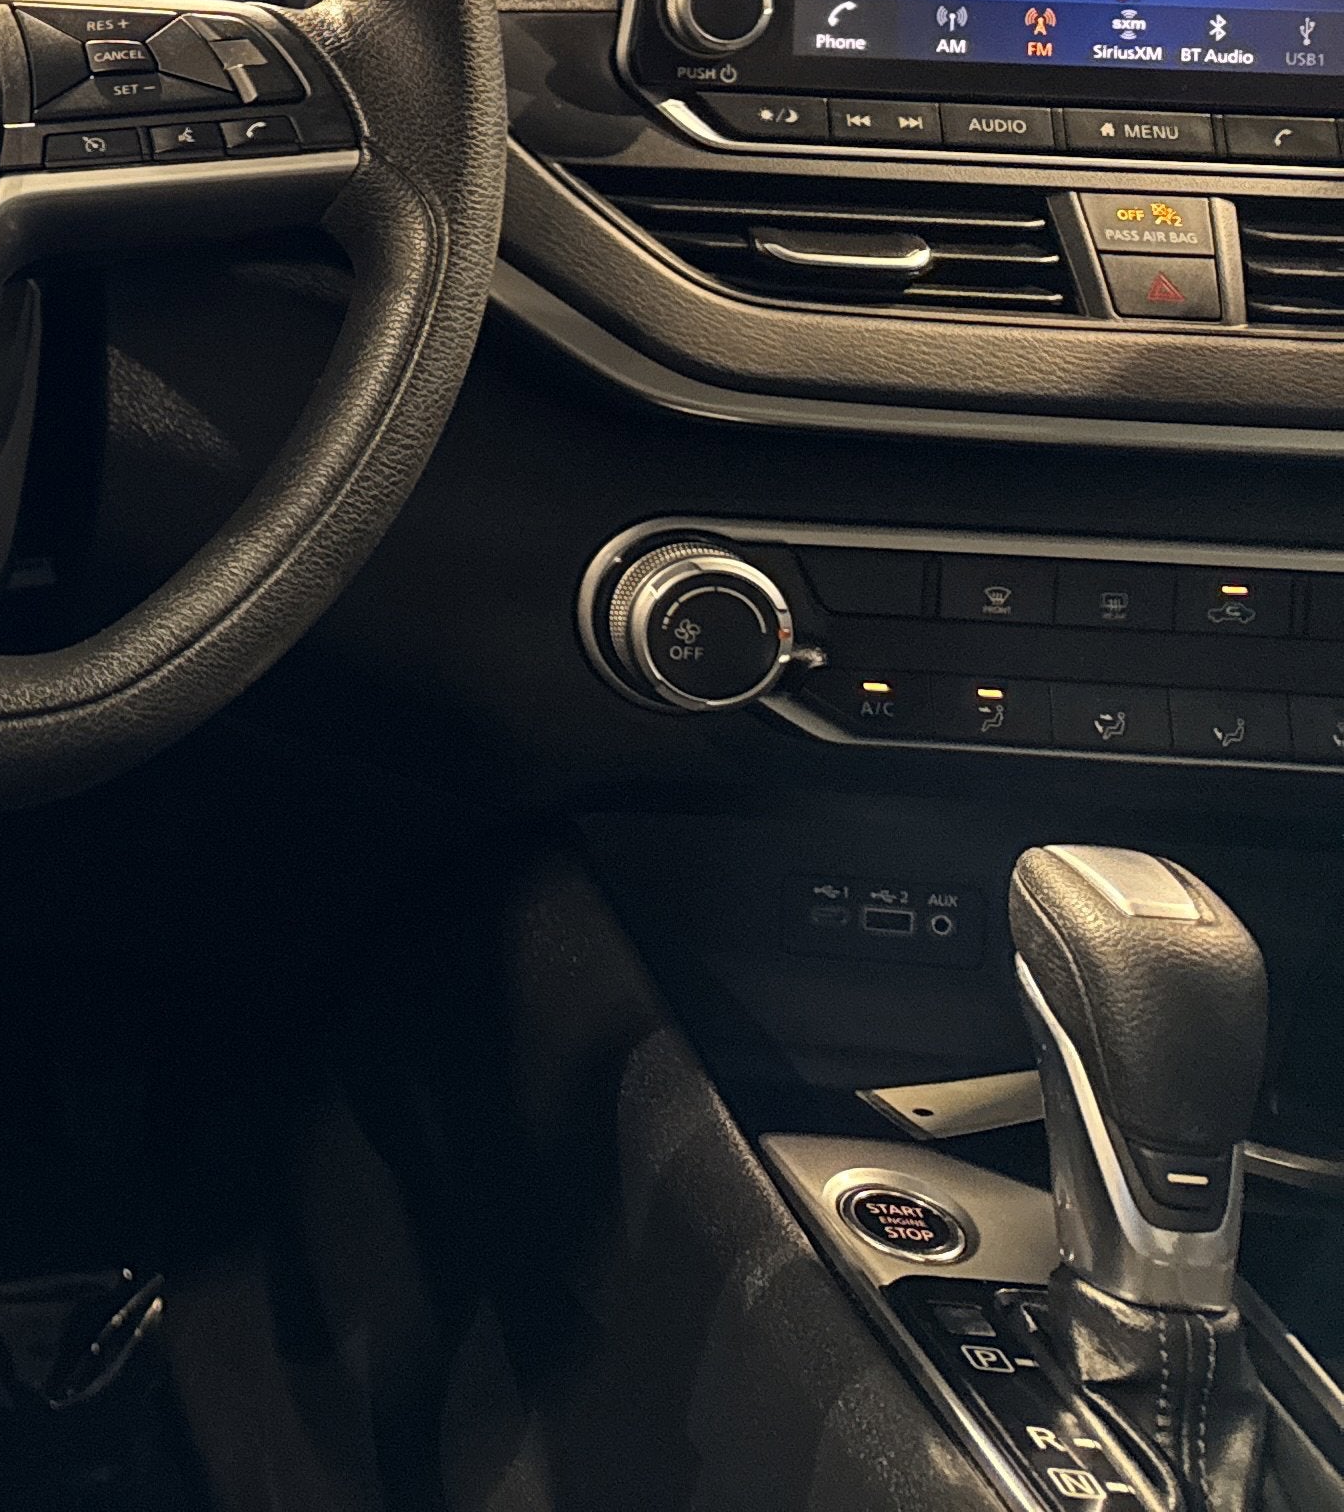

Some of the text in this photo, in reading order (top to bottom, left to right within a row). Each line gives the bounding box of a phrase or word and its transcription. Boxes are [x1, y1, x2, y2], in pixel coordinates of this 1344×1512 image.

[86, 20, 115, 32] RES
[1112, 18, 1146, 31] sxm
[815, 34, 867, 51] Phone
[935, 39, 966, 54] AM
[1027, 42, 1053, 57] FM
[93, 50, 146, 63] CANCEL
[1093, 44, 1163, 61] SiriusXM
[1180, 48, 1254, 65] BT Audio
[1285, 51, 1325, 67] USB1
[677, 68, 716, 80] PUSH
[113, 84, 138, 96] SET
[968, 115, 1027, 135] AUDIO
[1124, 124, 1179, 140] MENU
[1116, 209, 1145, 222] OFF
[1104, 228, 1198, 245] PASS AIR BAG
[669, 645, 705, 661] OFF
[861, 702, 895, 718] A/C
[928, 893, 959, 908] AUX
[865, 1202, 925, 1219] START
[884, 1225, 935, 1242] STOP
[973, 1349, 998, 1368] P
[1025, 1425, 1068, 1452] R
[1059, 1473, 1095, 1495] N
